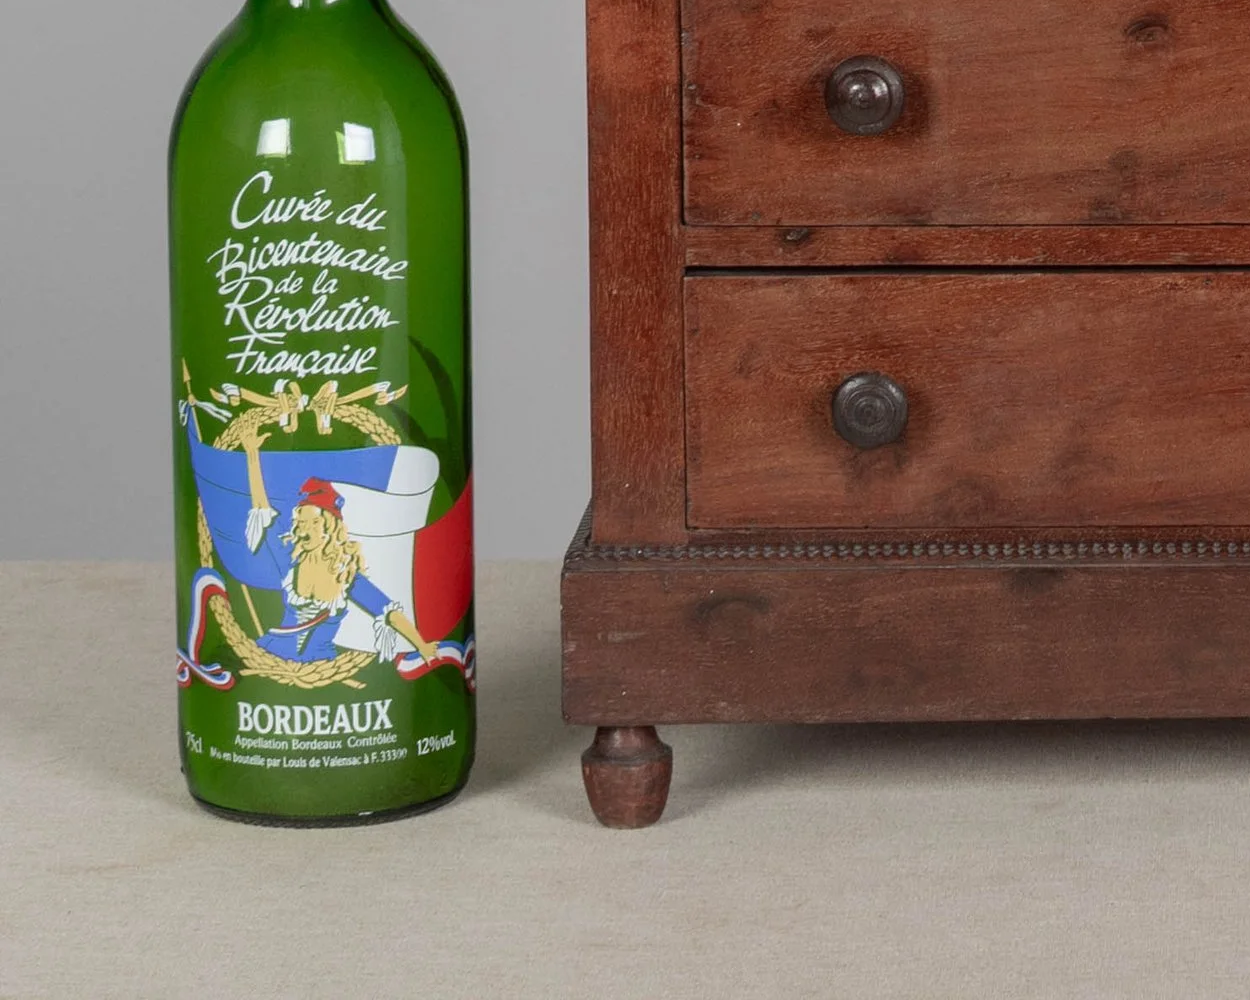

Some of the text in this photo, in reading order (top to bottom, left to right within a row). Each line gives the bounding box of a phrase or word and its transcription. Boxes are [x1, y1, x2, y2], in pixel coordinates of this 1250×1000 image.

[231, 170, 387, 231] Cuvée du
[206, 232, 408, 295] Bicentenaire
[275, 269, 339, 295] de la
[224, 276, 400, 345] Révolution
[226, 332, 378, 378] Française
[237, 699, 393, 735] BORDEAUX
[232, 752, 265, 766] bouteille
[266, 758, 281, 769] par
[283, 757, 307, 767] Louis
[309, 757, 320, 767] de
[234, 734, 288, 750] Appellation
[291, 738, 342, 750] Bordeaux
